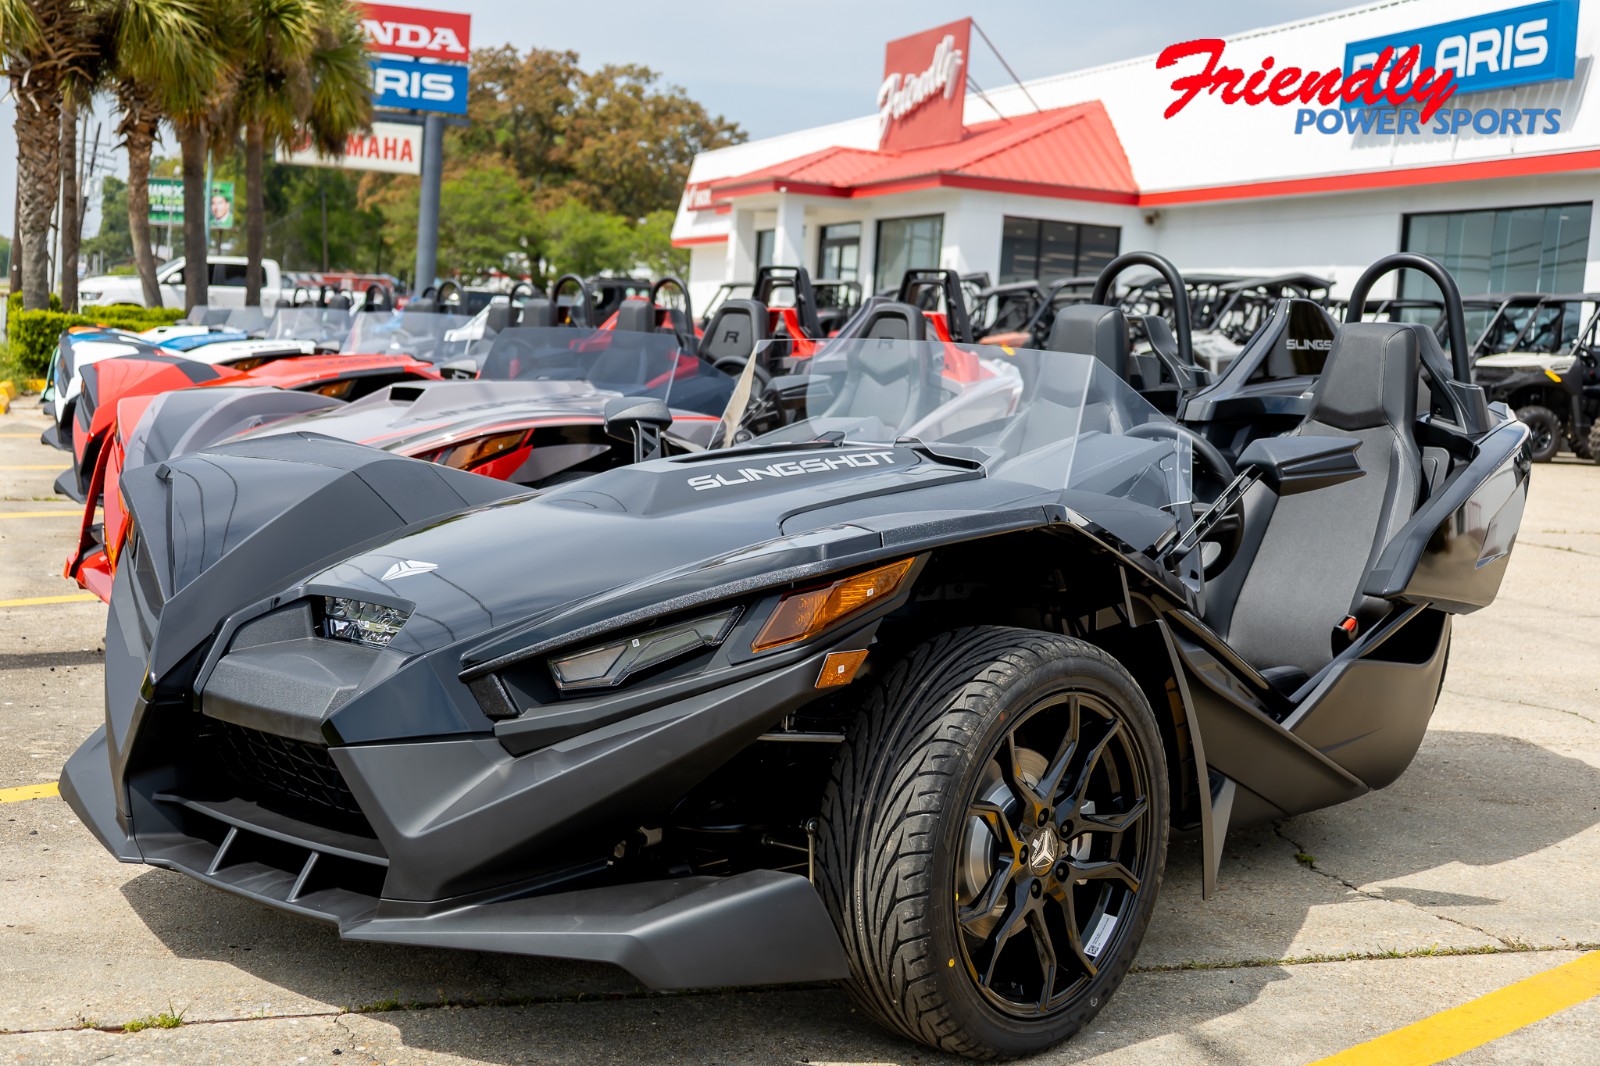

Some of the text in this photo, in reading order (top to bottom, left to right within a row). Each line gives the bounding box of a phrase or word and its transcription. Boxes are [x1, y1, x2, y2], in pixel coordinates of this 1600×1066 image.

[354, 19, 466, 53] NDA
[345, 131, 413, 163] MAHA
[723, 330, 740, 344] R
[687, 452, 895, 491] SLINGSHOT
